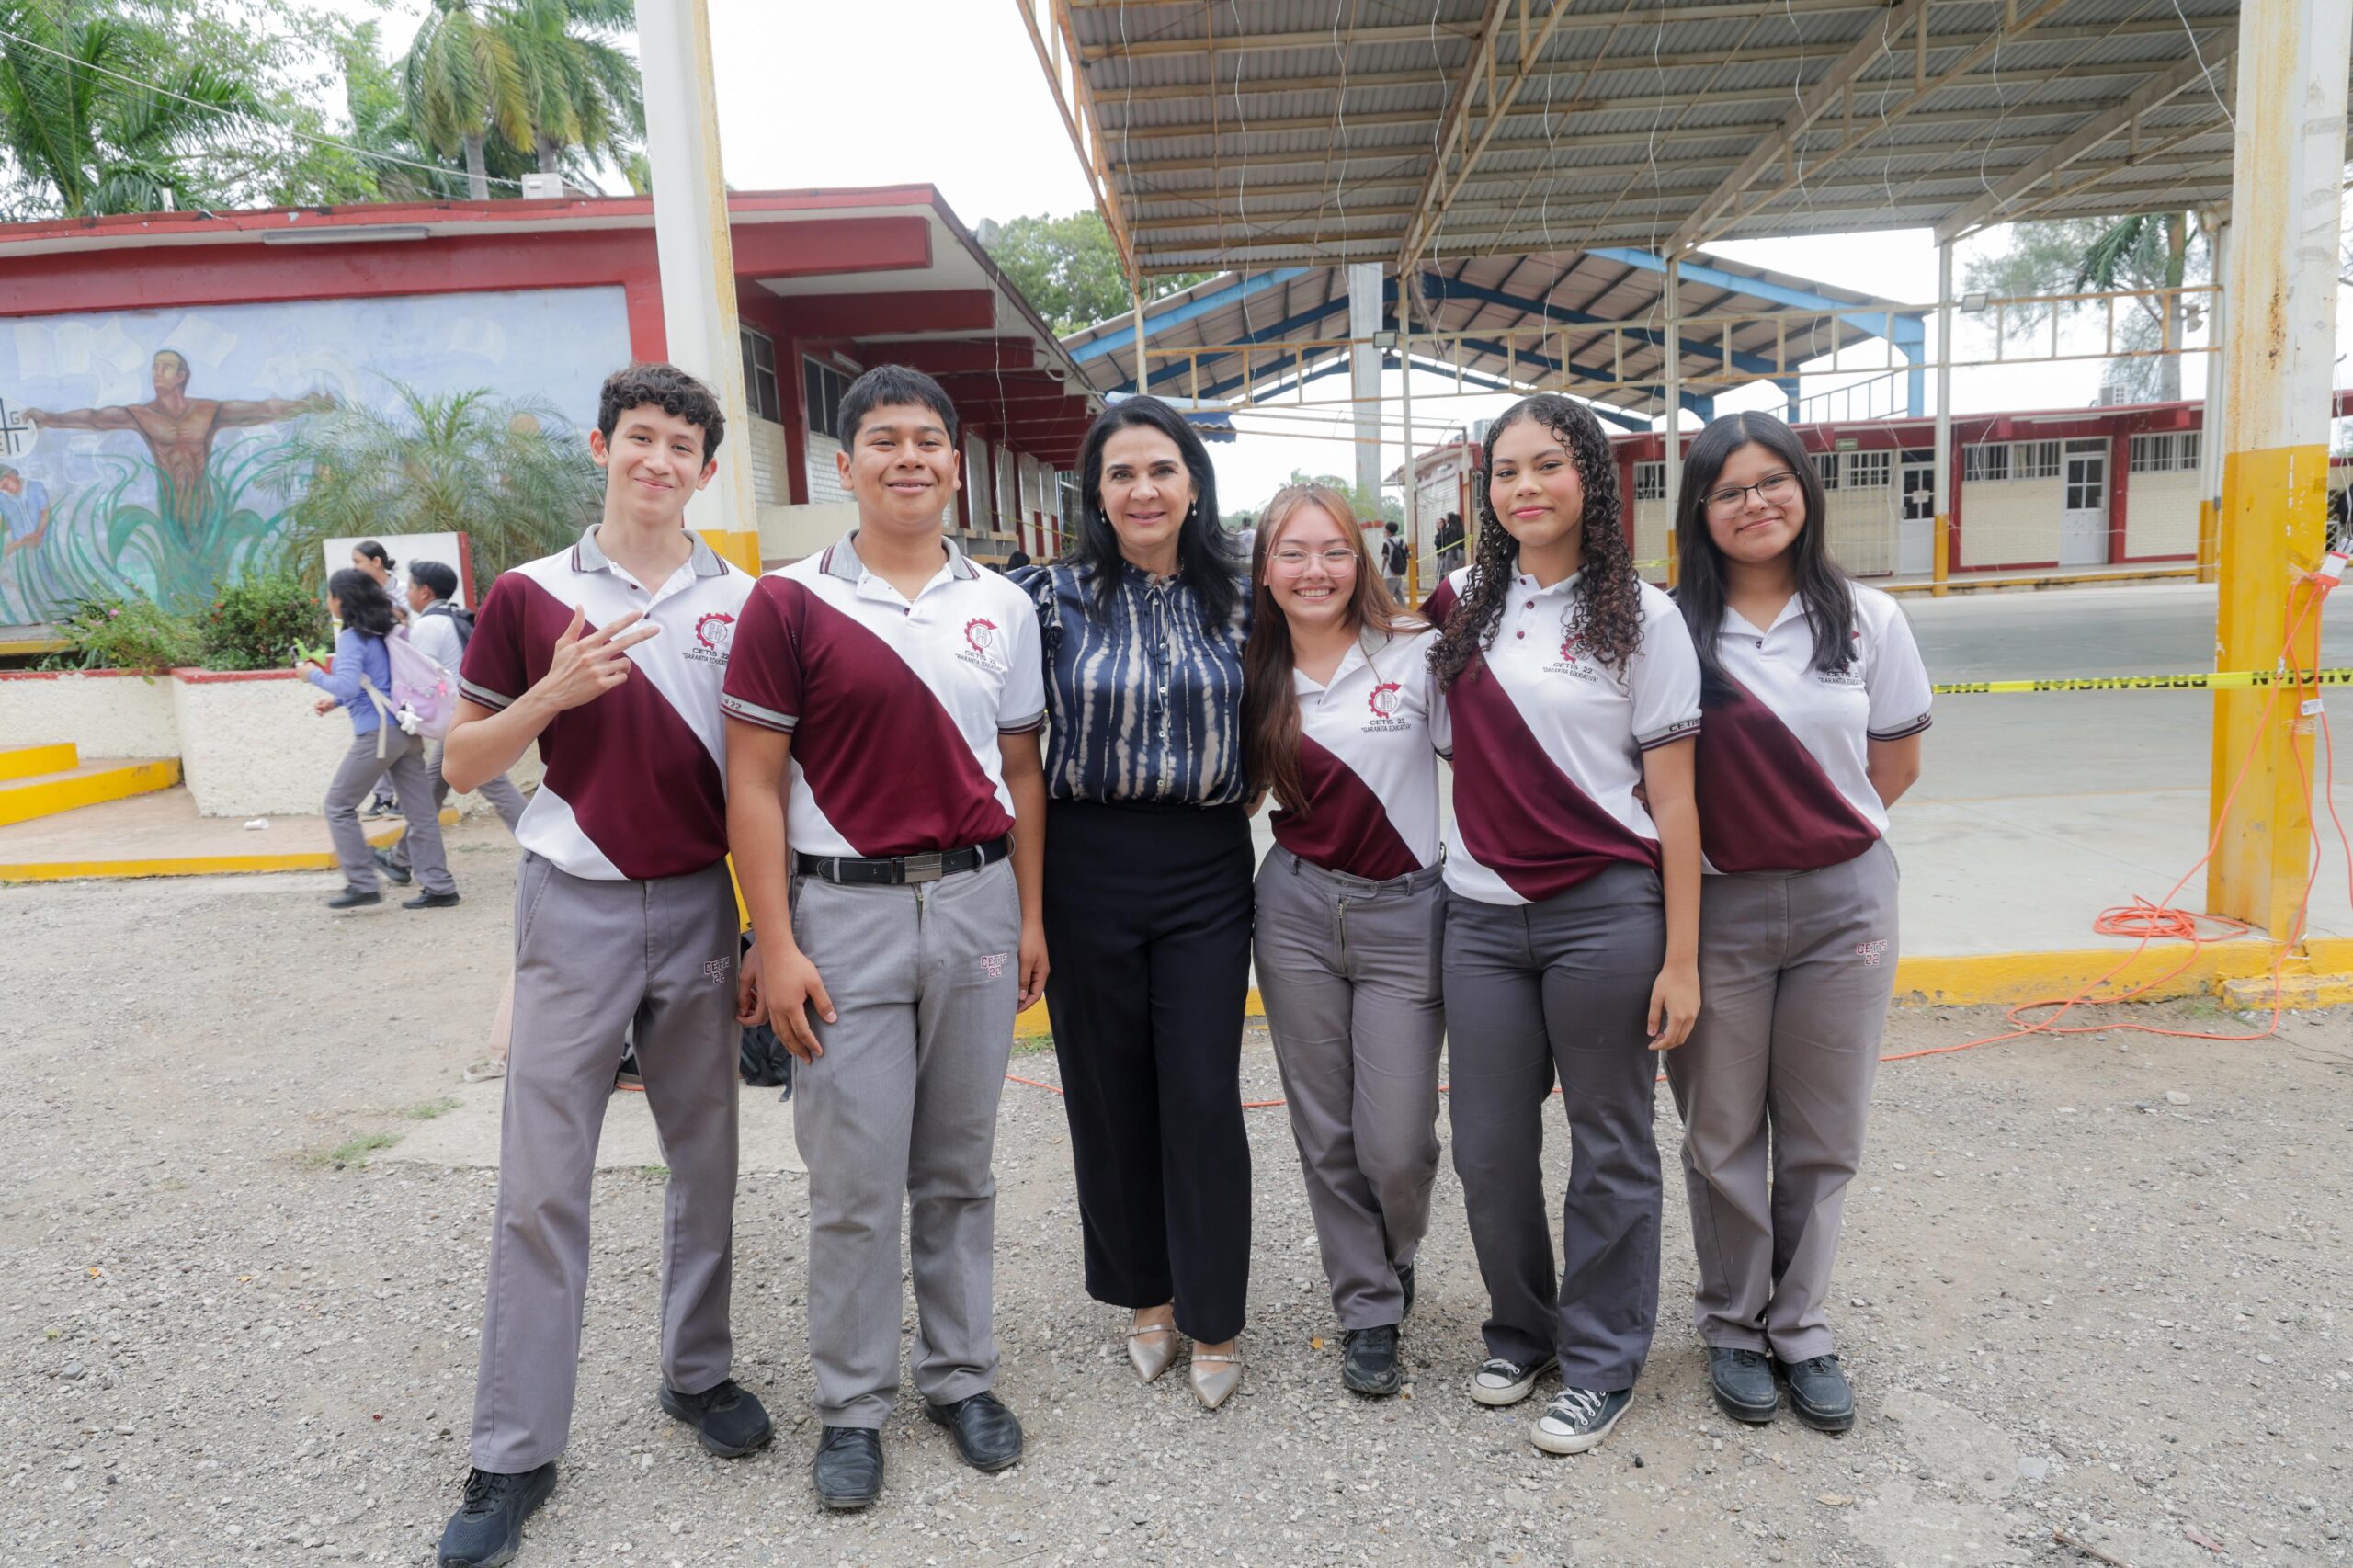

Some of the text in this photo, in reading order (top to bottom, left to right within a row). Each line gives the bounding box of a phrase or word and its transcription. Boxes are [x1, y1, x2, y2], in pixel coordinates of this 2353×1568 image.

[1583, 666, 1593, 675] 22
[1864, 952, 1880, 966] 22
[712, 970, 726, 984] 22
[988, 965, 1002, 979] 22
